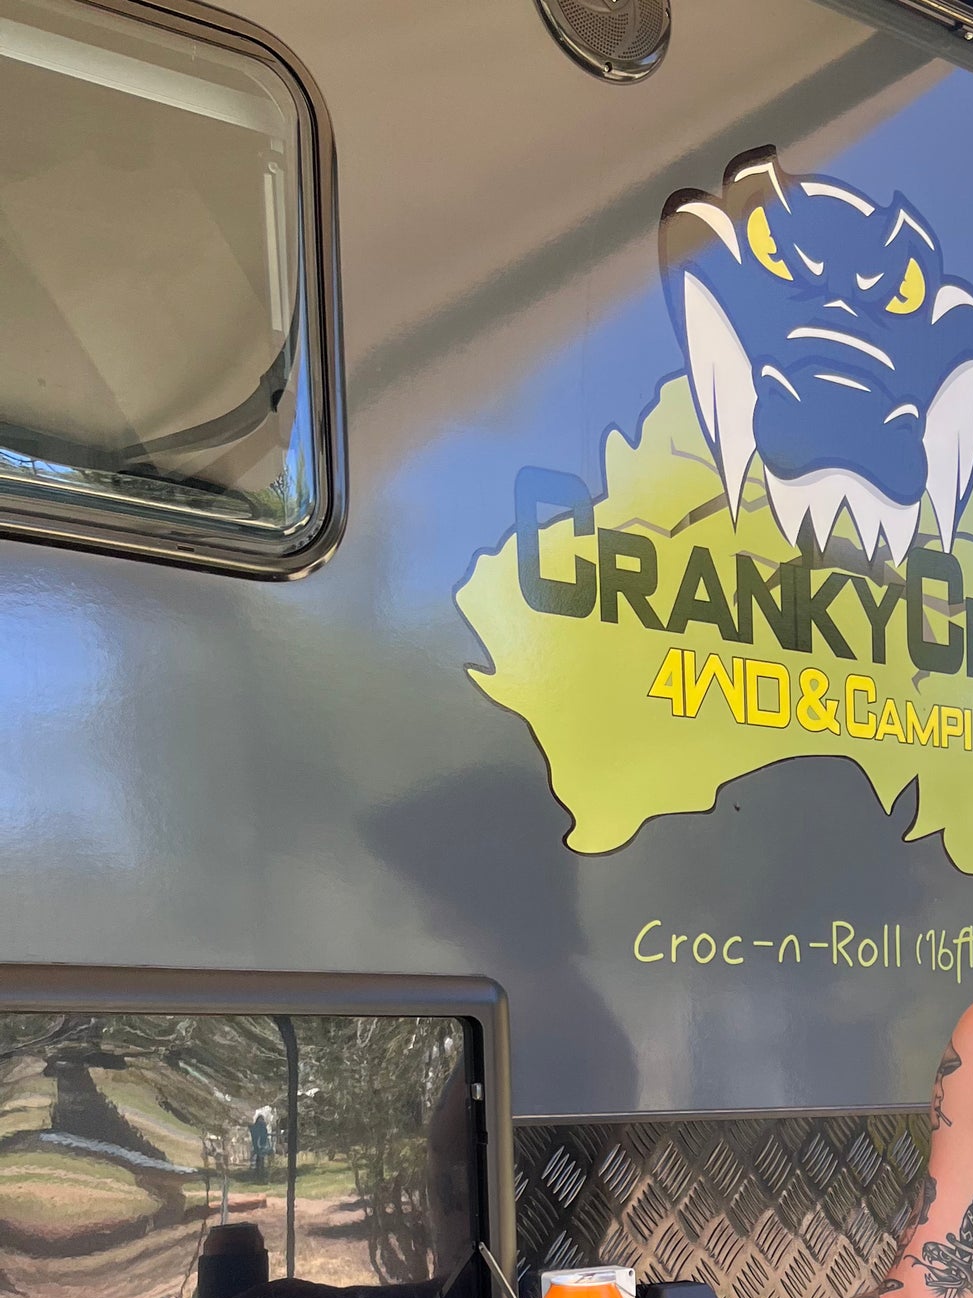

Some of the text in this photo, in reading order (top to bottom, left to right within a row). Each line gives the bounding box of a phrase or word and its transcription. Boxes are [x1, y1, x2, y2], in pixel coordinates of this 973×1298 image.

[647, 648, 791, 729] 4WD
[796, 667, 841, 735] &
[633, 919, 901, 968] Croc-n-Roll
